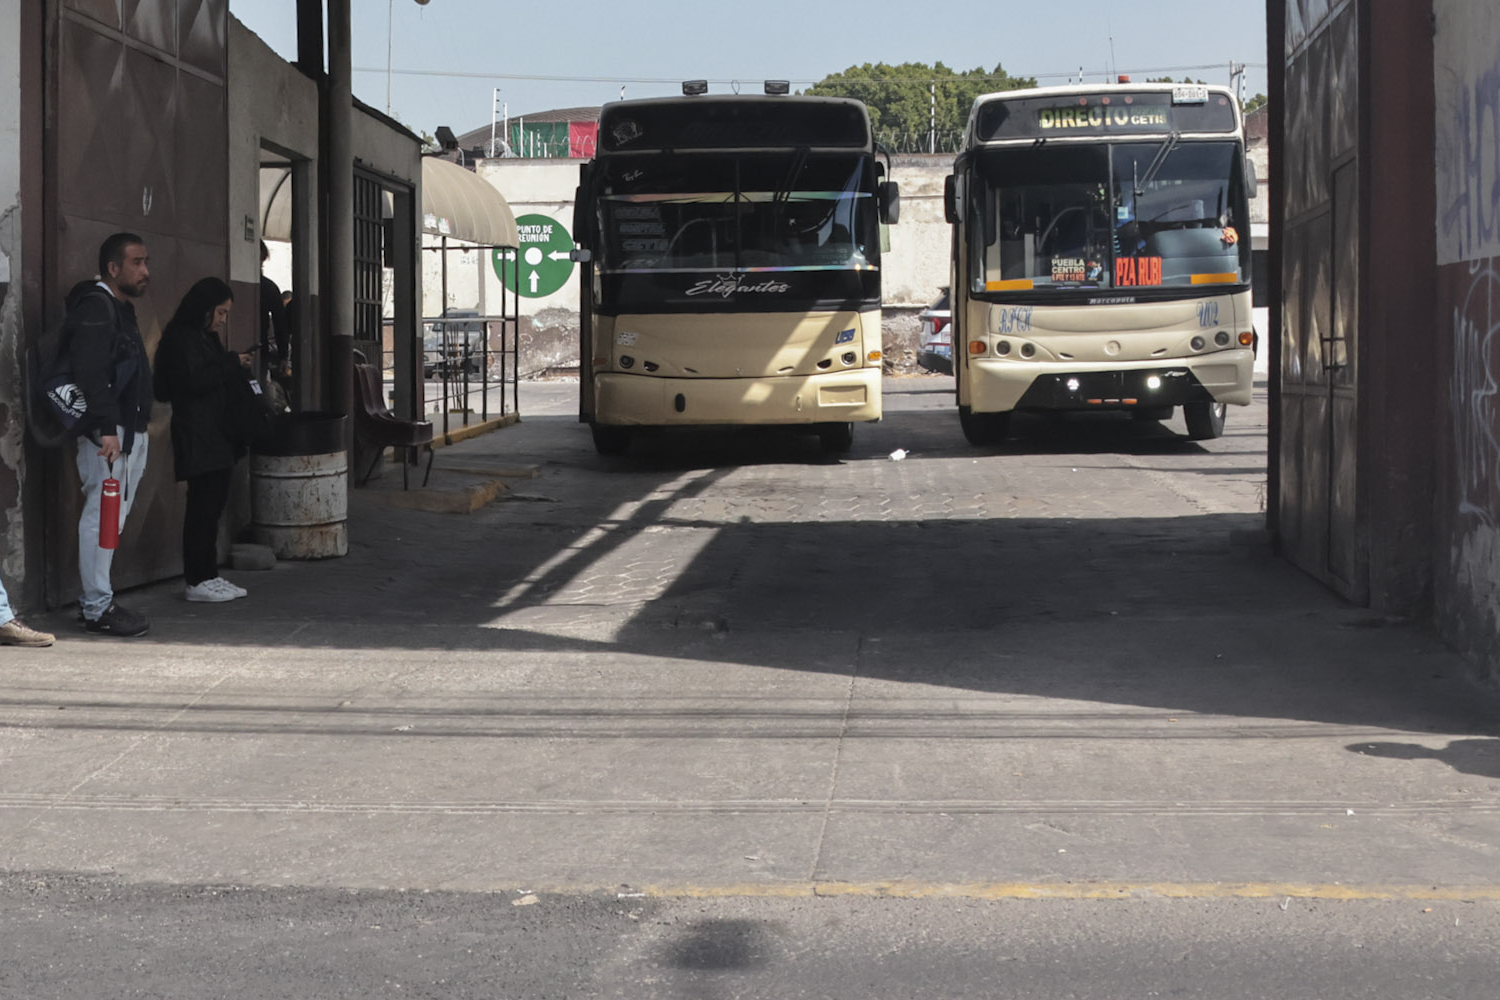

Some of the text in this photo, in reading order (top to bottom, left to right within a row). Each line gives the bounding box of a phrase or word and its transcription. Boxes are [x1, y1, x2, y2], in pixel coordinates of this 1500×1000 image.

[1039, 105, 1129, 129] DIRECTO
[516, 224, 553, 234] PUNTO DE
[1051, 258, 1085, 267] PUEBLA
[1051, 266, 1085, 274] CENTRO
[1115, 256, 1162, 286] PZA RUBI
[685, 280, 792, 298] Elegantes
